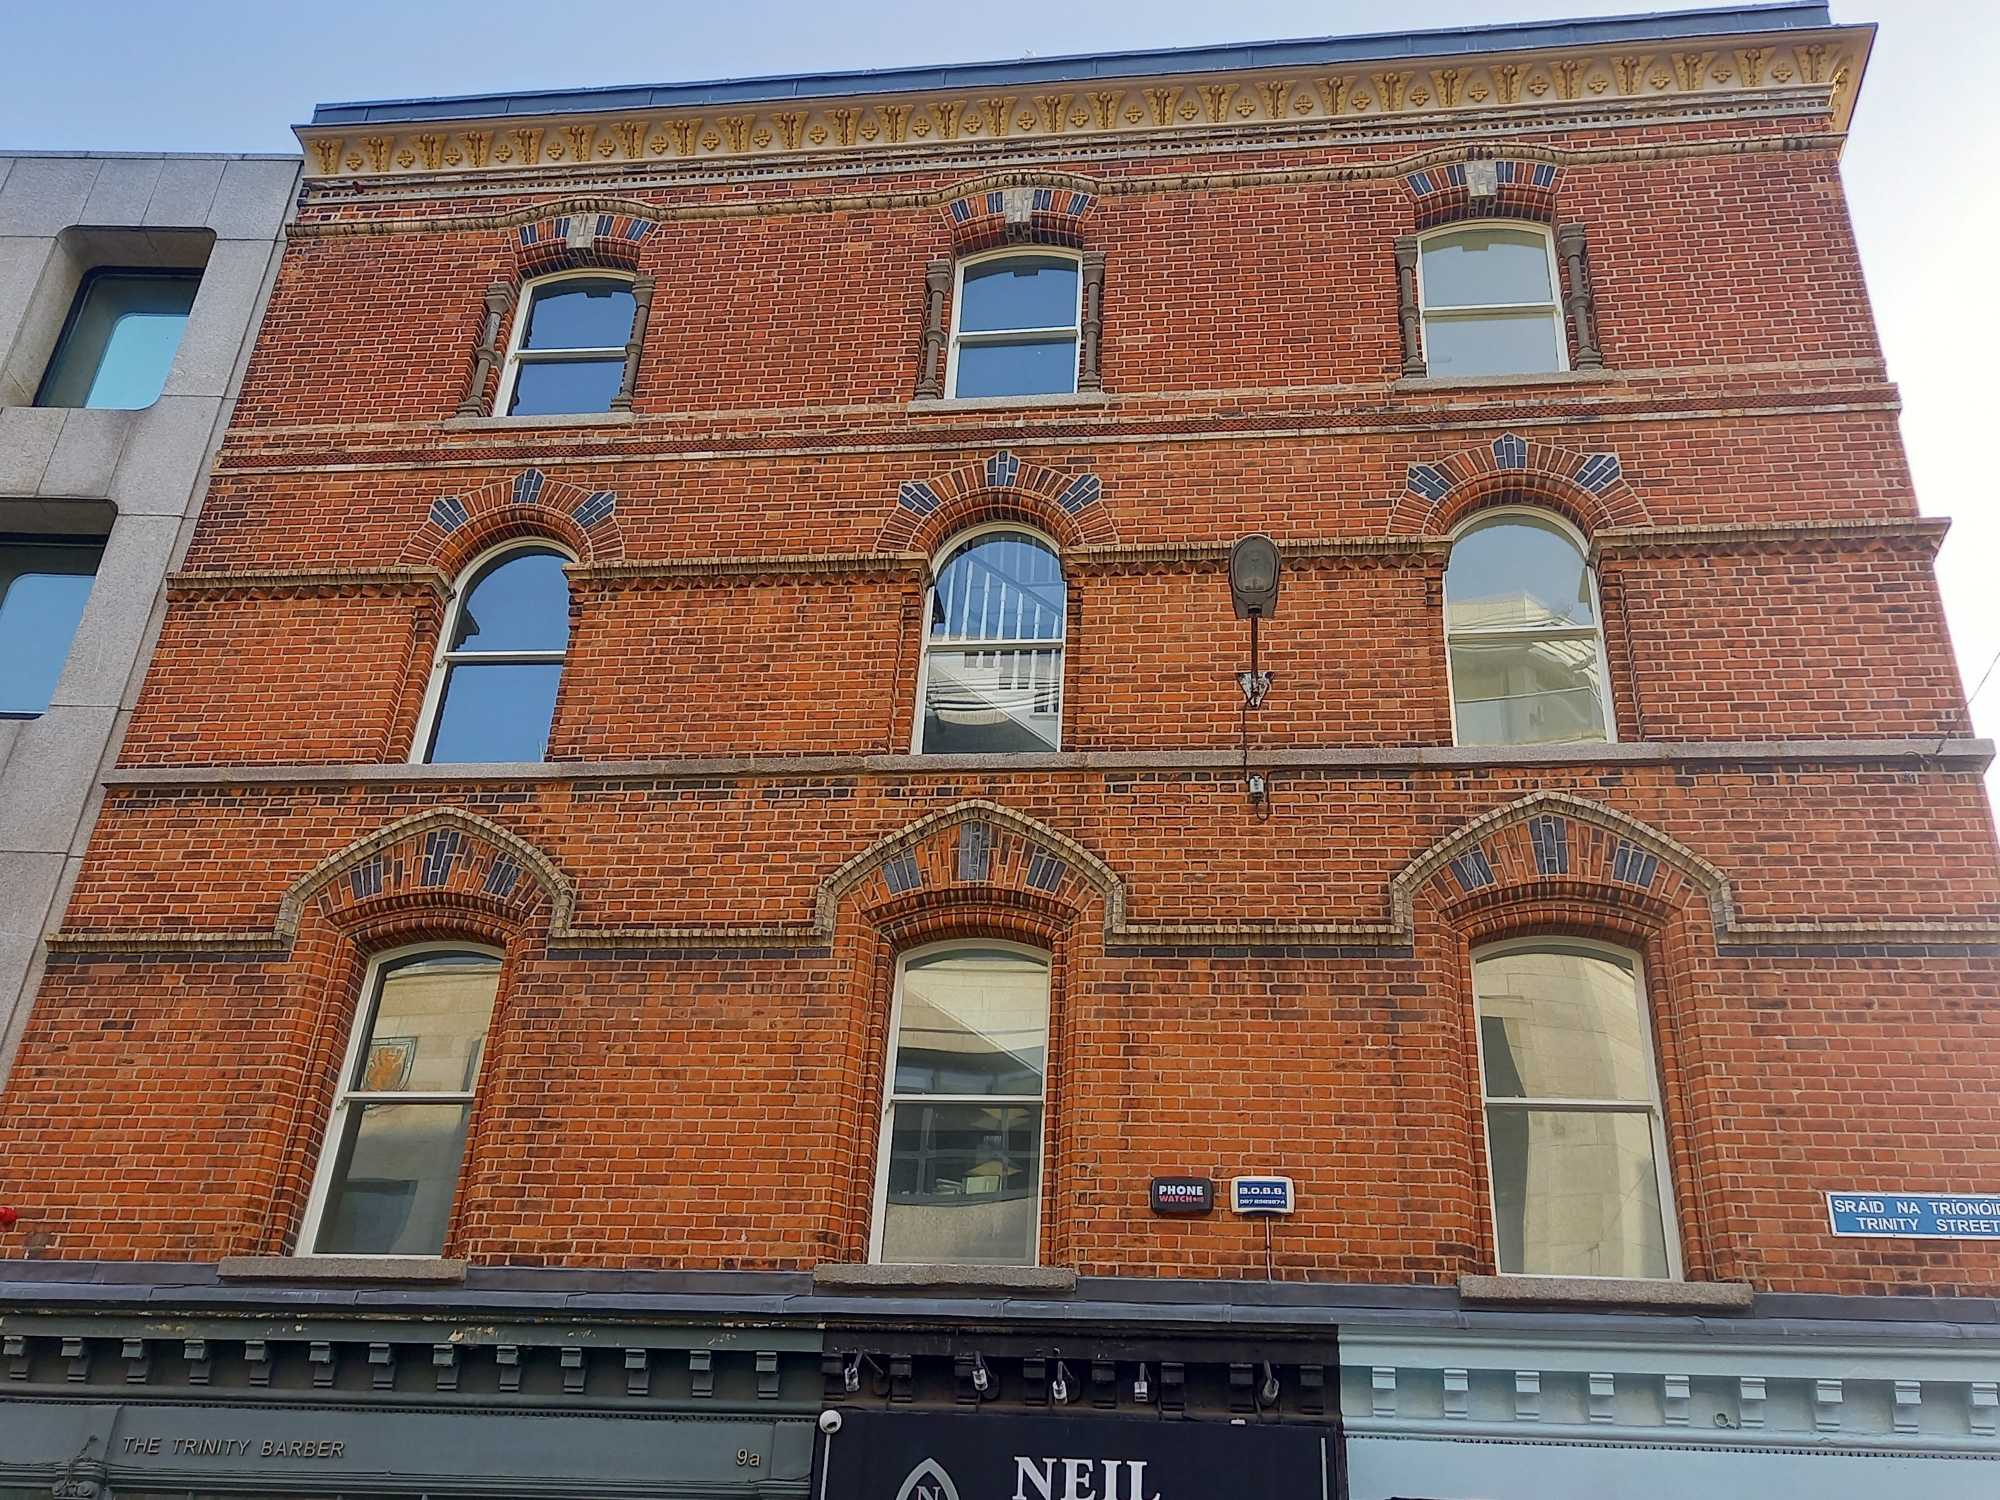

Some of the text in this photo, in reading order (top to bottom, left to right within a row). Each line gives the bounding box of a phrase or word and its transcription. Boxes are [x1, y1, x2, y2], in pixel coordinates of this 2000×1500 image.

[1158, 1185, 1204, 1196] PHONE
[1159, 1195, 1193, 1203] WATCH
[1834, 1198, 1884, 1213] SRÁID
[1897, 1202, 1921, 1214] NA
[1856, 1217, 2000, 1233] TRINITY STREET
[123, 1437, 345, 1458] THE TRINITY BARBER
[736, 1448, 760, 1467] 9a
[1012, 1456, 1161, 1500] NEIL
